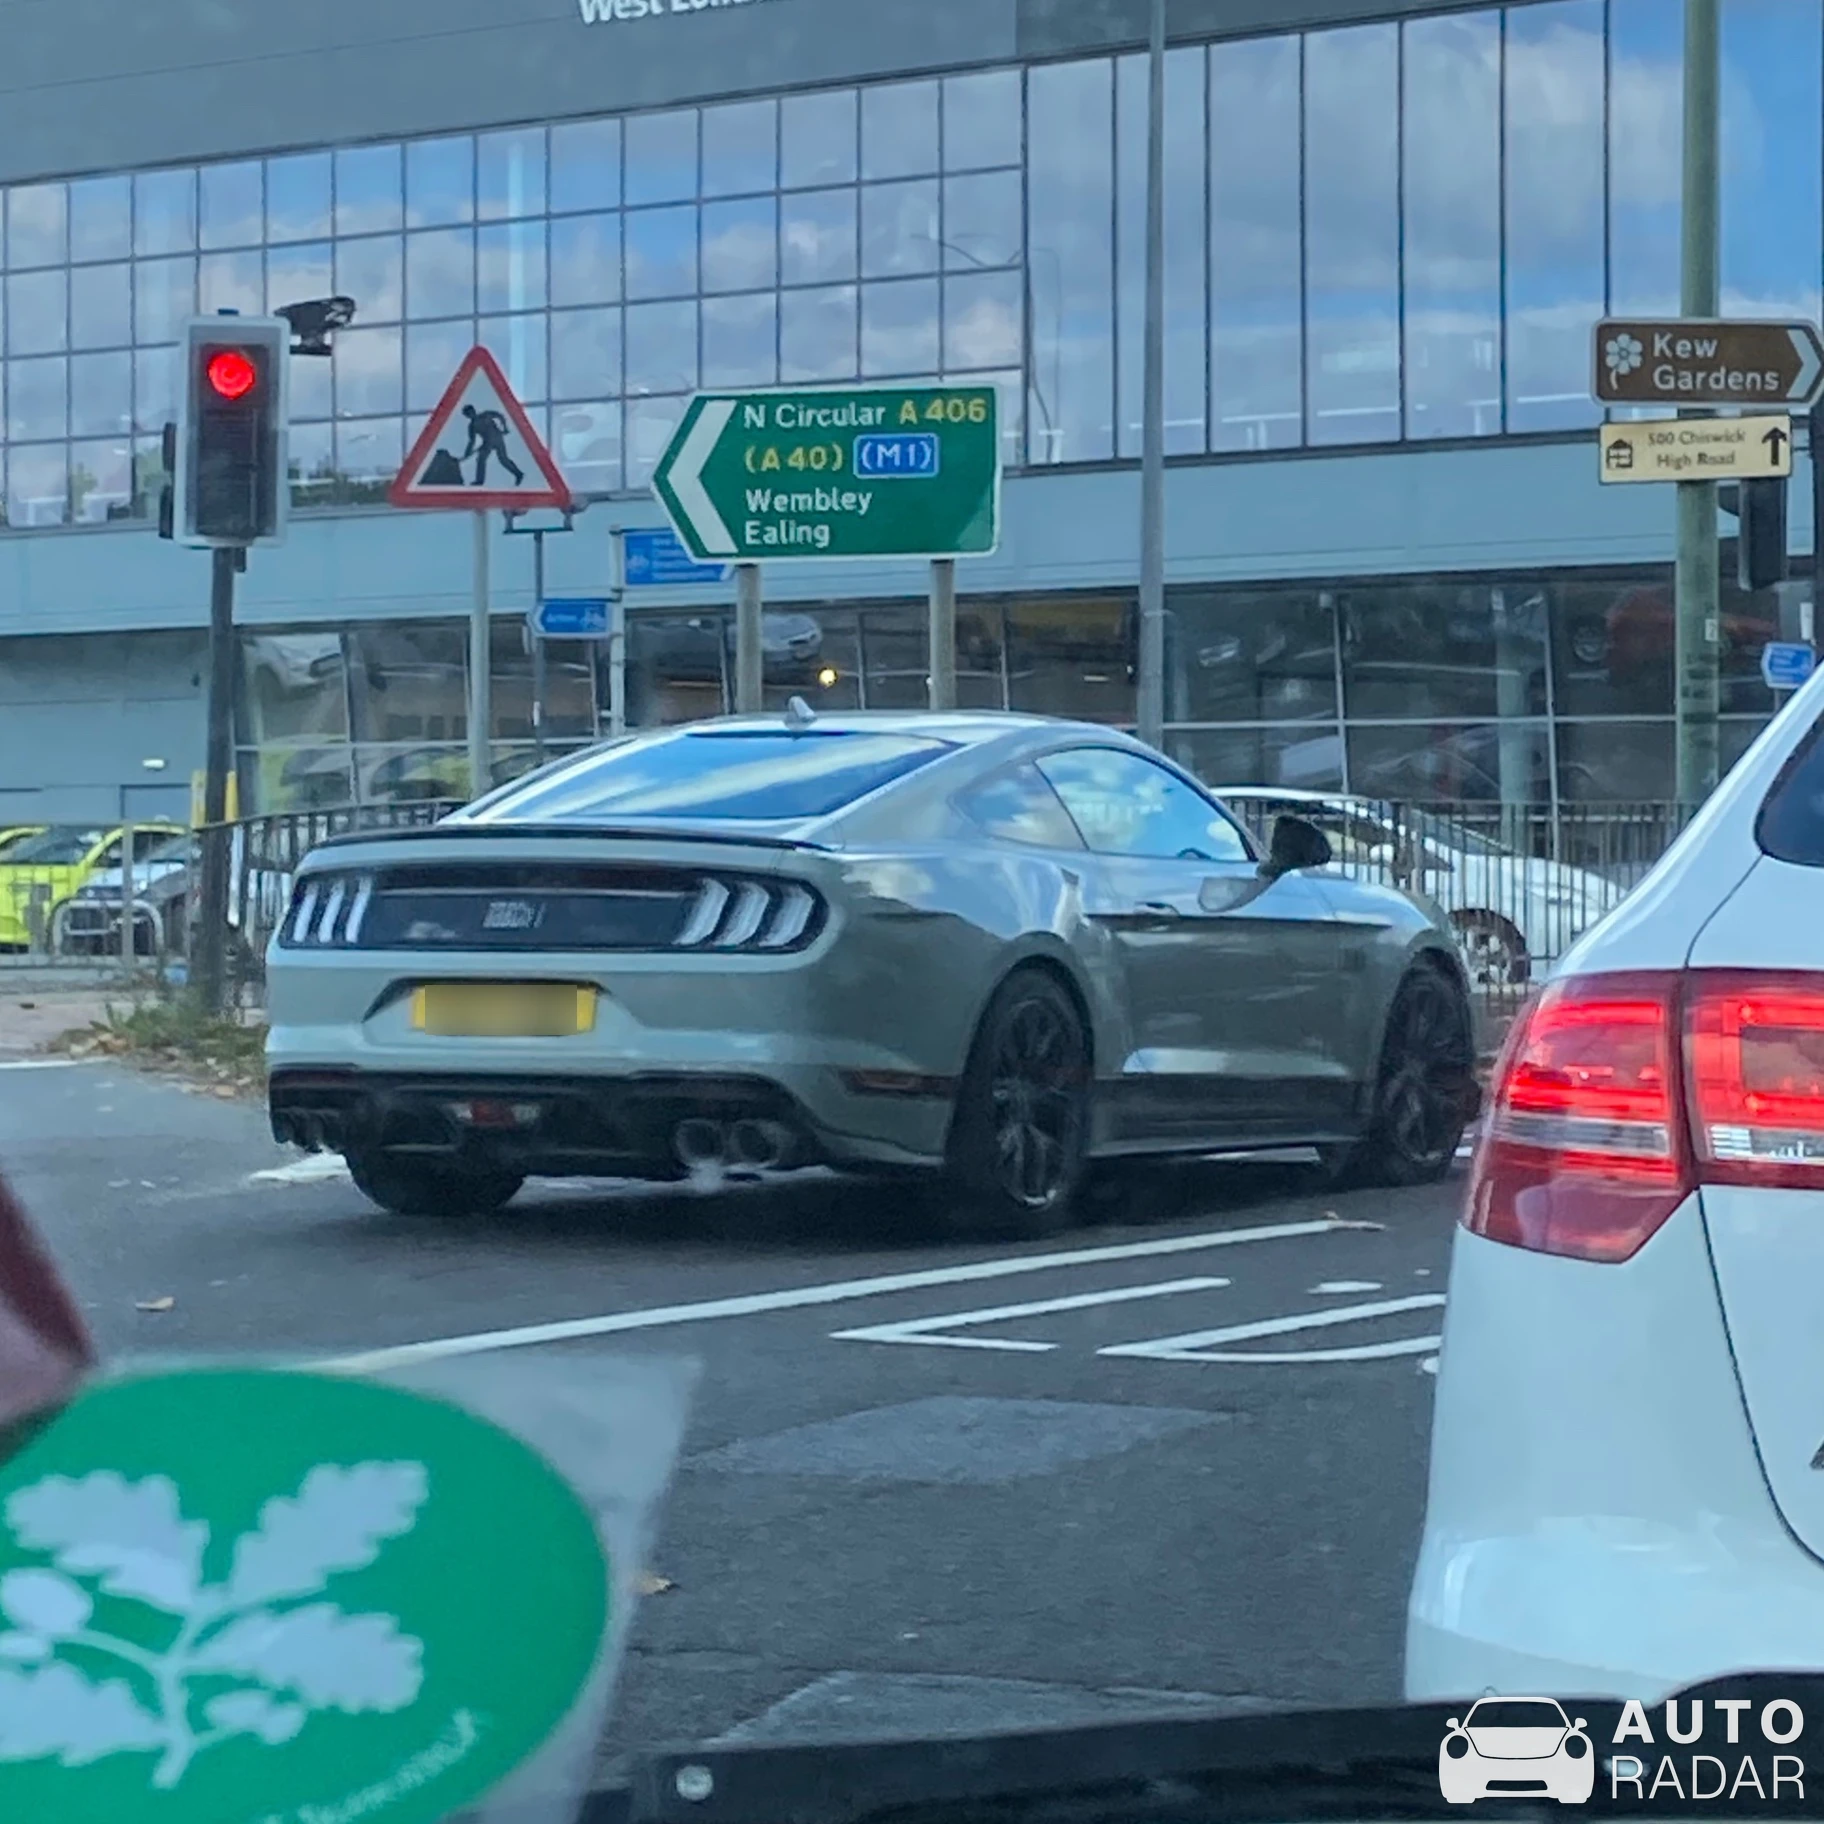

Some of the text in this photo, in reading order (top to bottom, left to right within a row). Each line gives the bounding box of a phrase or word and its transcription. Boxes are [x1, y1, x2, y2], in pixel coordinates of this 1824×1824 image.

[1653, 332, 1719, 359] Kew
[1653, 365, 1779, 392] Gardens
[743, 404, 765, 429] N
[775, 400, 886, 429] Circular
[861, 441, 932, 470] (M1)
[1697, 450, 1736, 466] Road
[745, 487, 873, 516] Wembley
[745, 520, 831, 547] Ealing
